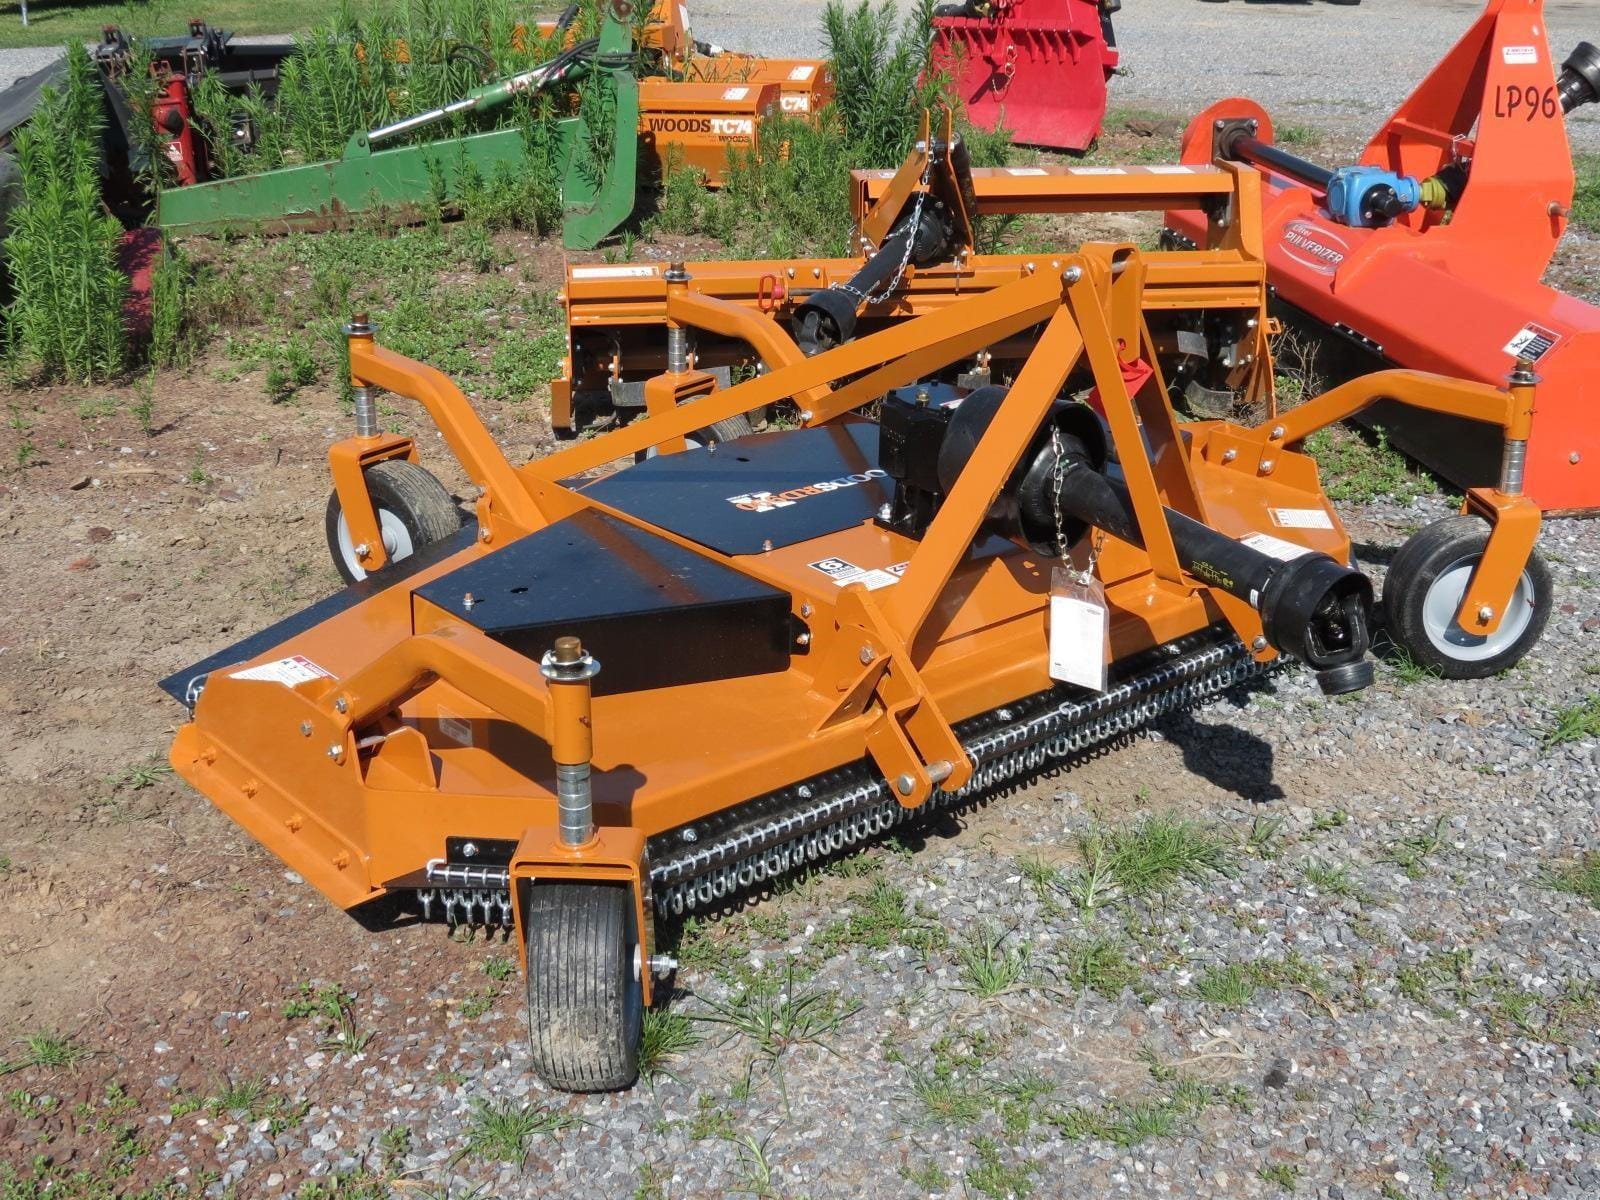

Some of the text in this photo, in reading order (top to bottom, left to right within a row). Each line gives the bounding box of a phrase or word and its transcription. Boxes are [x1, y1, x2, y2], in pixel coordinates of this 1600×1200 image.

[780, 96, 808, 111] C74
[1495, 85, 1556, 122] LP96
[648, 119, 753, 135] WOODS TC74
[1284, 231, 1344, 264] PULVERIZER
